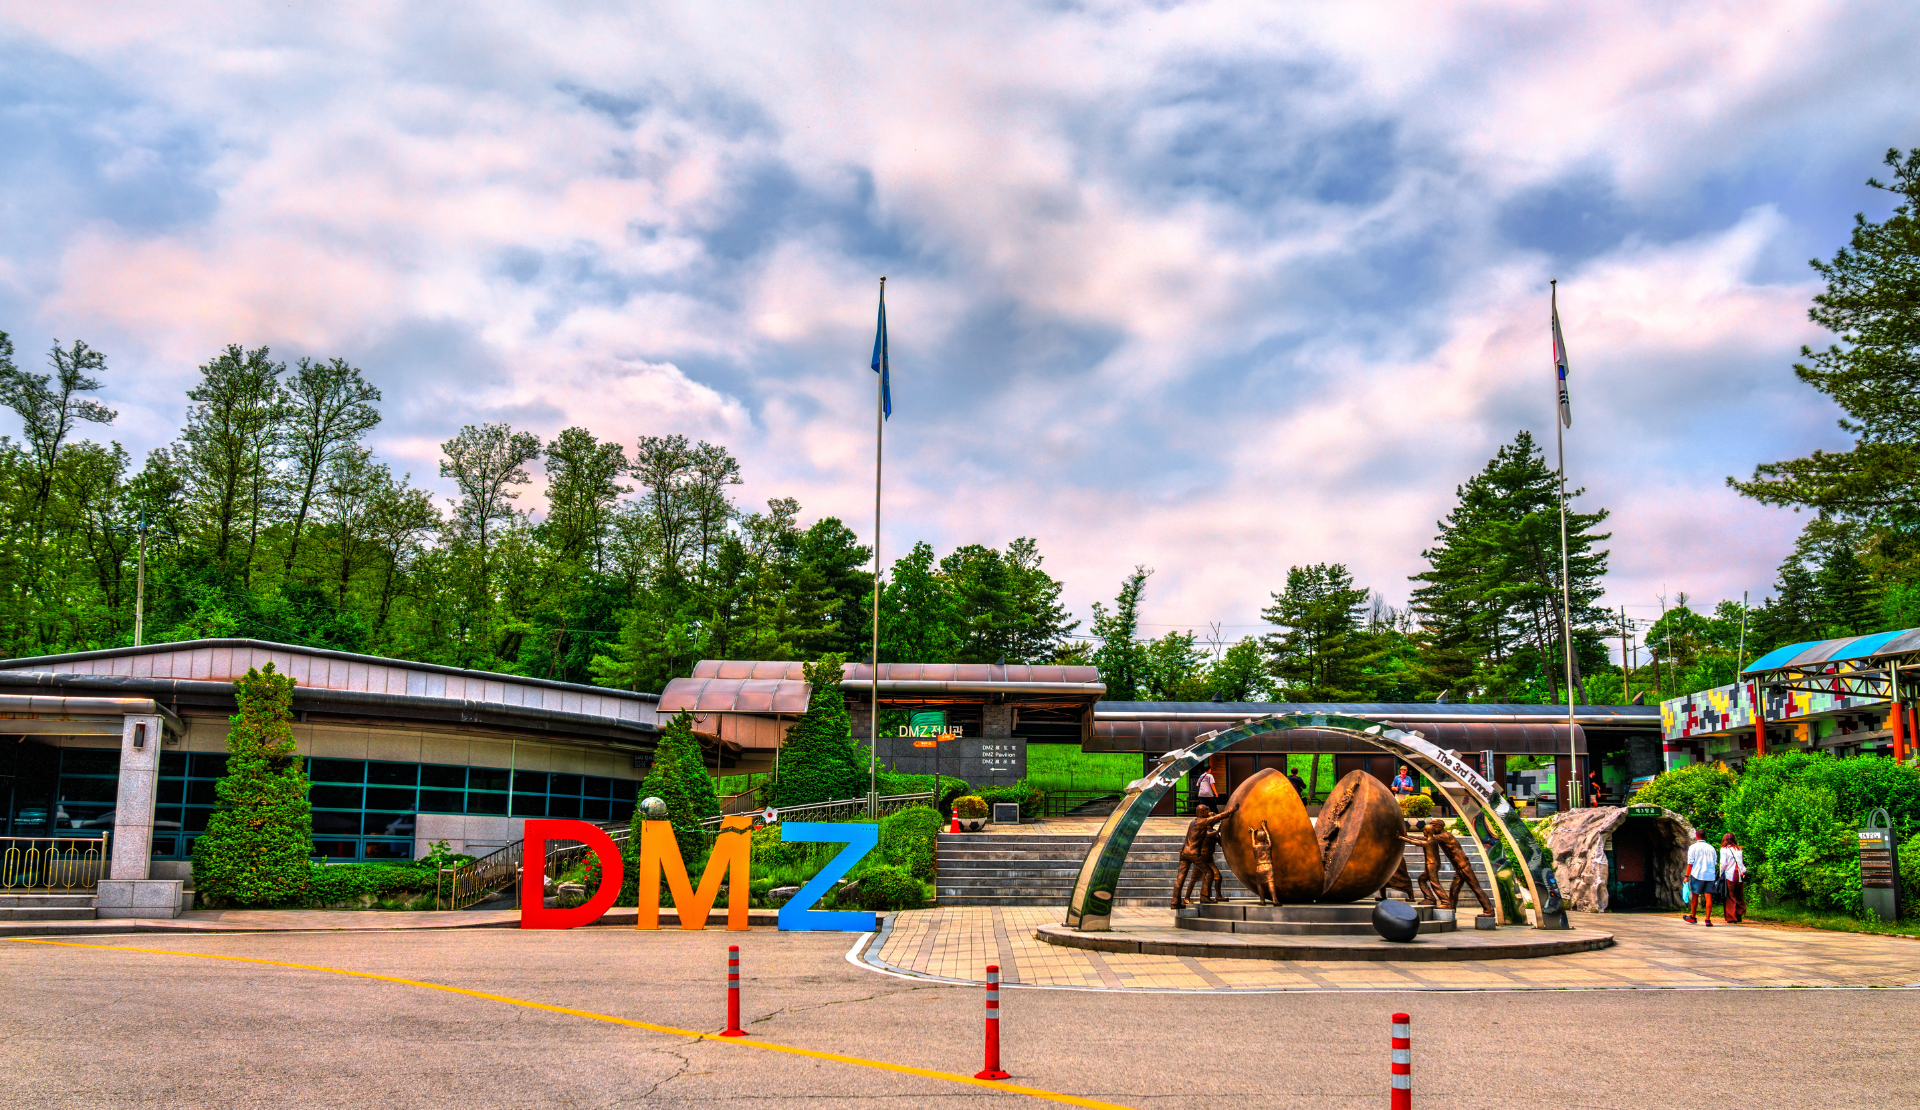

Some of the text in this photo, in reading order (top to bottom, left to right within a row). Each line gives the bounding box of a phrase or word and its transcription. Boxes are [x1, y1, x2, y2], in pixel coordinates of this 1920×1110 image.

[899, 725, 963, 738] DMZ 전시관
[1436, 749, 1453, 767] The
[1452, 762, 1469, 779] 3rd
[521, 815, 879, 933] DMZ
